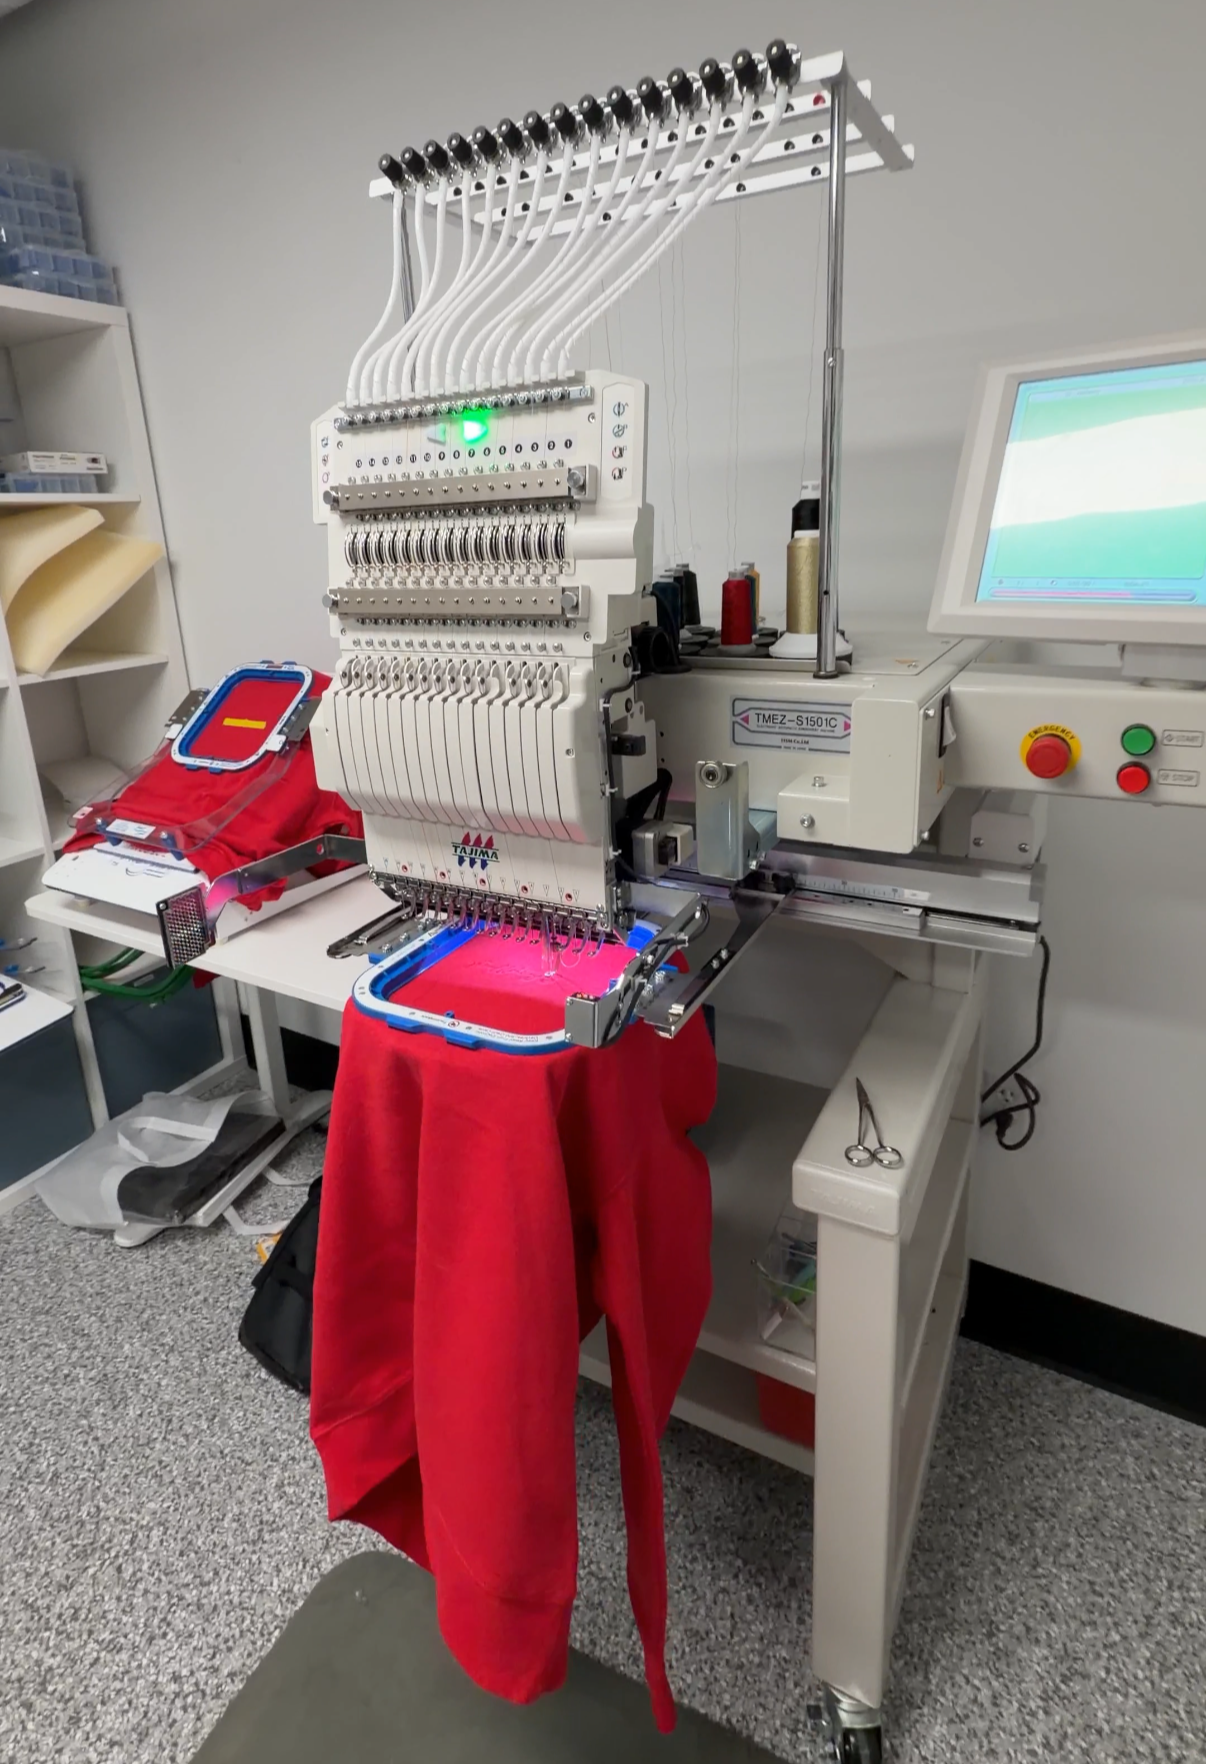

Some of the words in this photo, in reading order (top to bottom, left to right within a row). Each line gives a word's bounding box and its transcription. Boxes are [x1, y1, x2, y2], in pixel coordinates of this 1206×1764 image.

[755, 712, 838, 728] TMEZ-S1501C
[1028, 724, 1076, 742] EMERGENCY
[452, 844, 499, 860] TAJIMA
